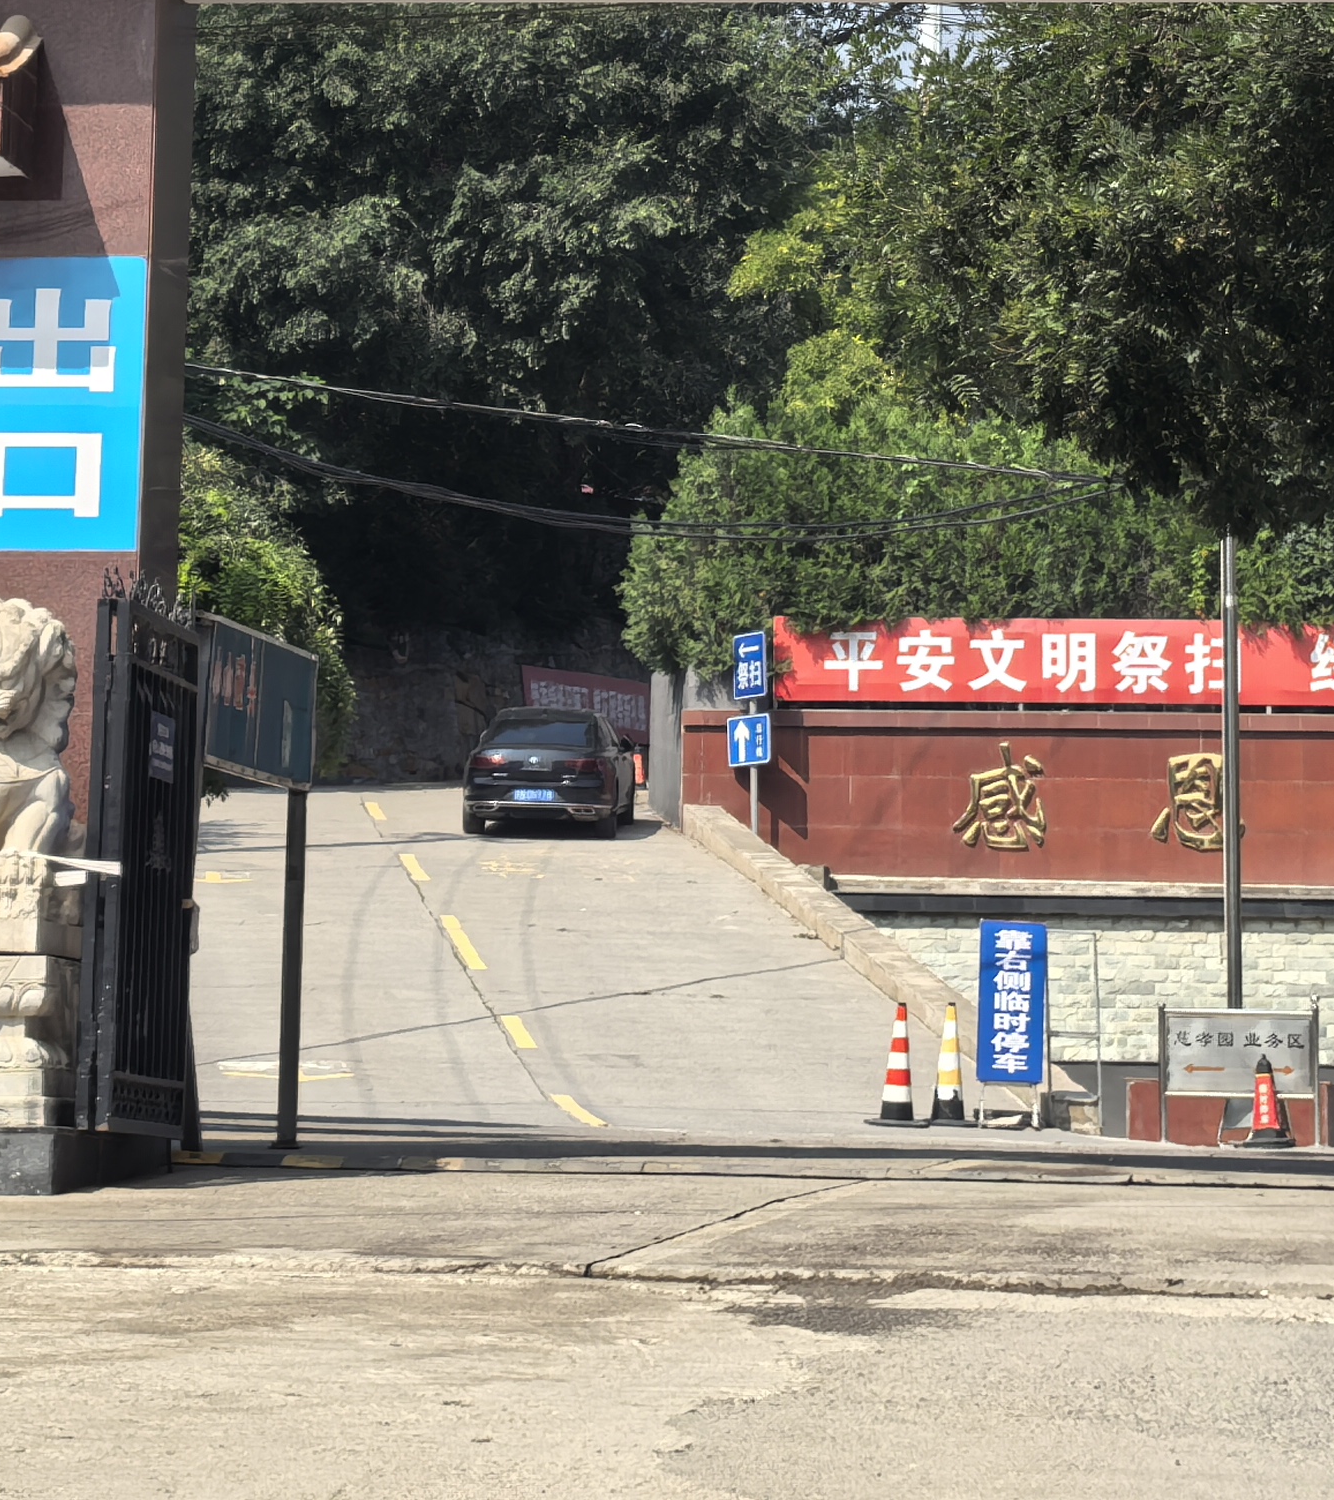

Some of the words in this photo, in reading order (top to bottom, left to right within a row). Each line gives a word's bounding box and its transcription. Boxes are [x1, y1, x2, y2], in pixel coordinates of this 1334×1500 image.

[737, 660, 762, 690] 祭扫
[823, 629, 1242, 694] 平安文明祭扫
[990, 929, 1033, 1074] 靠右侧临时停车
[1243, 1031, 1305, 1049] 业务区
